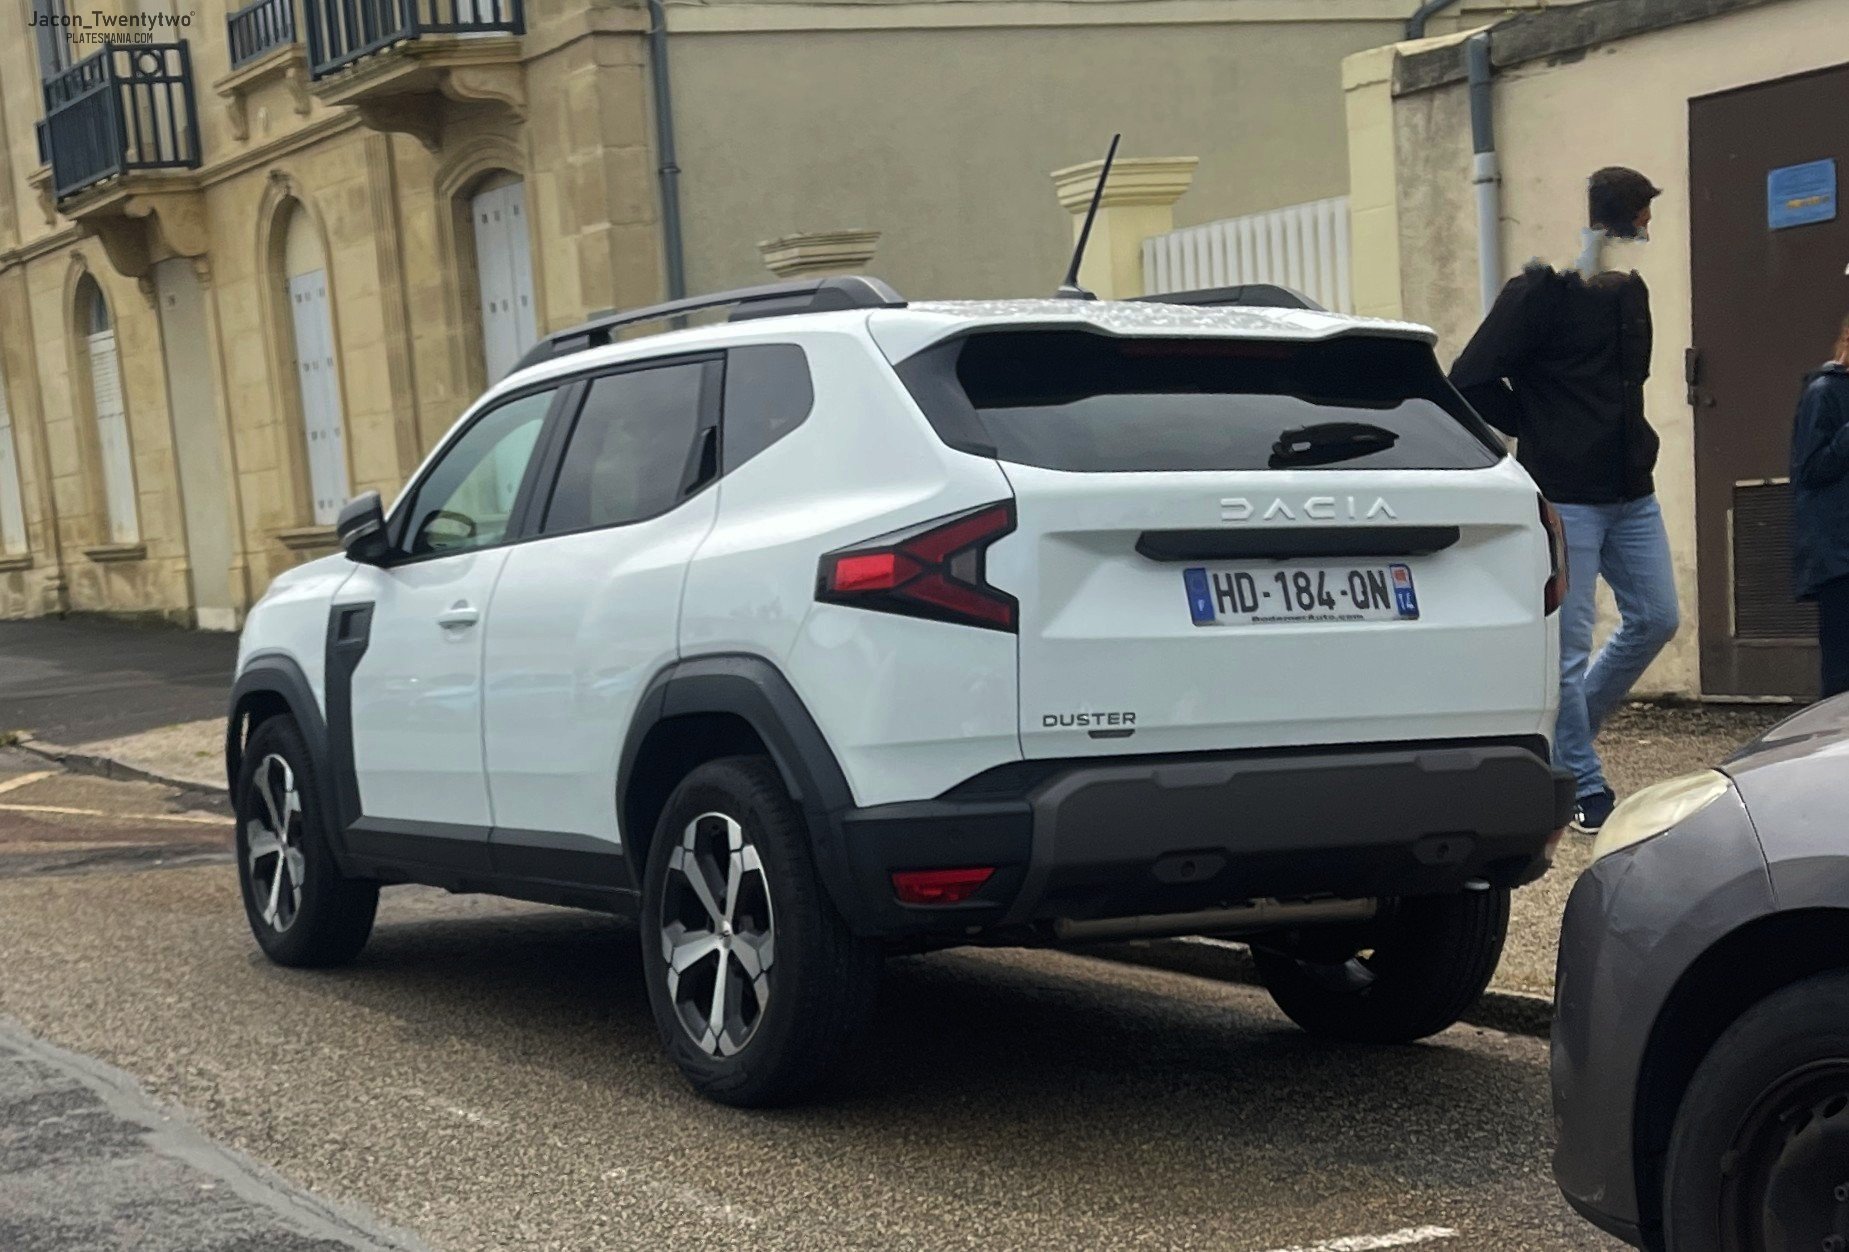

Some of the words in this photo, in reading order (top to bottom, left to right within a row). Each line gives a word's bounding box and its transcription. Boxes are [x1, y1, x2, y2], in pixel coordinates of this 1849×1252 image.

[1220, 496, 1397, 522] DACIA
[1213, 570, 1391, 614] HD-184-QN
[1398, 592, 1415, 610] 14
[1043, 712, 1136, 727] DUSTER
